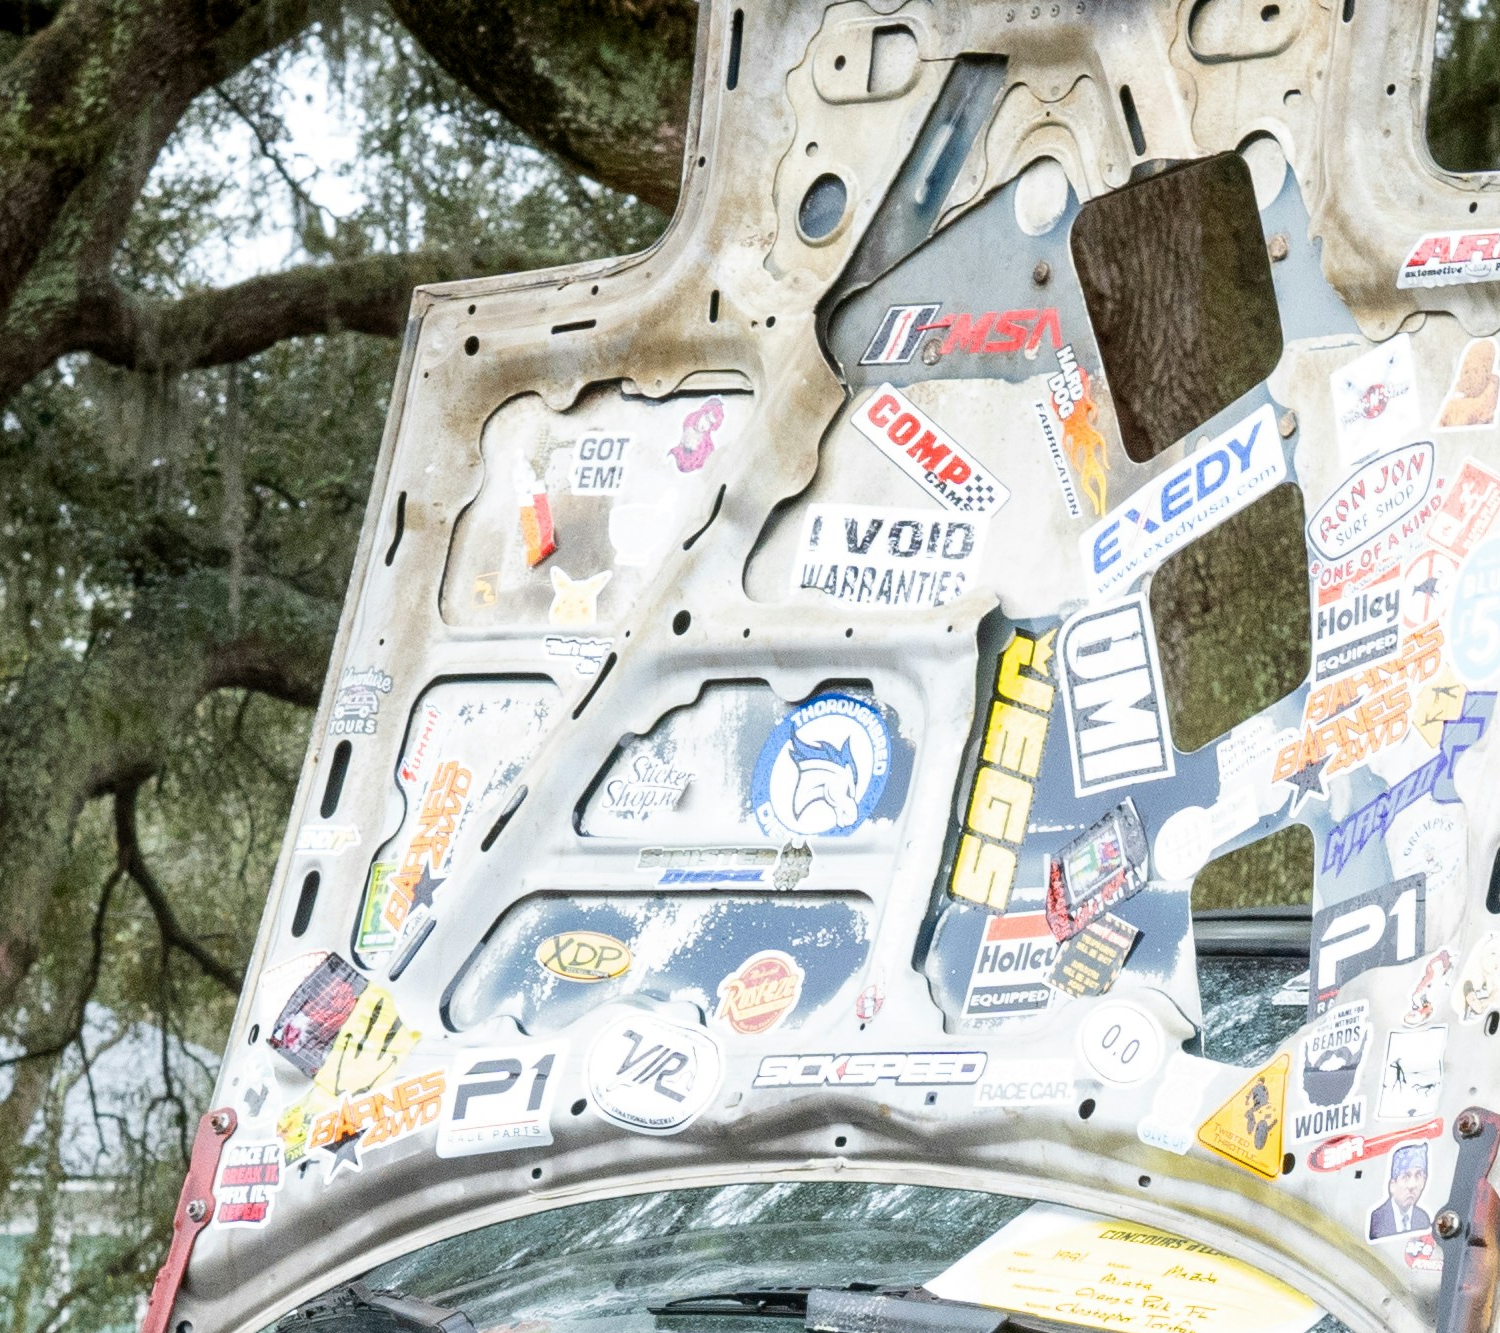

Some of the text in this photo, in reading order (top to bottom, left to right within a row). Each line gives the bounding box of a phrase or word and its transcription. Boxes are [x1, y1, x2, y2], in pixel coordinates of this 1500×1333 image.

[1047, 373, 1075, 419] DOG
[1055, 345, 1084, 402] HARD
[579, 437, 630, 461] GOT
[867, 394, 972, 486] COMP
[1035, 401, 1080, 518] FABRICATION
[574, 465, 624, 489] 'EM!
[1092, 420, 1263, 575] EXEDY
[1319, 451, 1425, 543] RON JON
[808, 514, 975, 560] I VOID
[1097, 463, 1278, 596] www.exedyusa.com
[1319, 561, 1354, 588] ONE
[1360, 542, 1383, 568] OF
[1387, 533, 1400, 550] A
[1401, 493, 1443, 539] KIND
[1335, 483, 1415, 548] SURF SHOP
[1317, 589, 1400, 641] Holley
[1316, 632, 1398, 674] EQUIPPED
[1065, 605, 1166, 784] UMI
[329, 718, 377, 735] TOURS
[789, 697, 891, 778] THOROUGHBRED
[1271, 682, 1413, 785] BARNES
[1326, 710, 1409, 776] 4WD
[628, 756, 698, 788] Sticker
[952, 627, 1058, 911] JEGS
[383, 760, 460, 933] BARNES
[544, 936, 623, 973] XDP
[1317, 887, 1418, 991] P1
[969, 988, 1050, 1008] EQUIPPED
[1101, 1023, 1140, 1065] 0.0
[1311, 1025, 1361, 1053] BEARDS
[452, 1053, 557, 1121] P1
[617, 1029, 691, 1104] VIR
[752, 1051, 988, 1089] SICKSPEED
[978, 1081, 1072, 1102] RACE CAR.
[307, 1070, 448, 1150] BARNES
[361, 1096, 443, 1149] 4WD
[493, 1124, 541, 1139] PARTS
[1213, 1120, 1251, 1149] TWISTED
[1294, 1101, 1363, 1140] WOMEN
[1212, 1135, 1259, 1164] THROTTLE
[1097, 1228, 1188, 1251] CONCOURS
[1099, 1272, 1154, 1292] Miata
